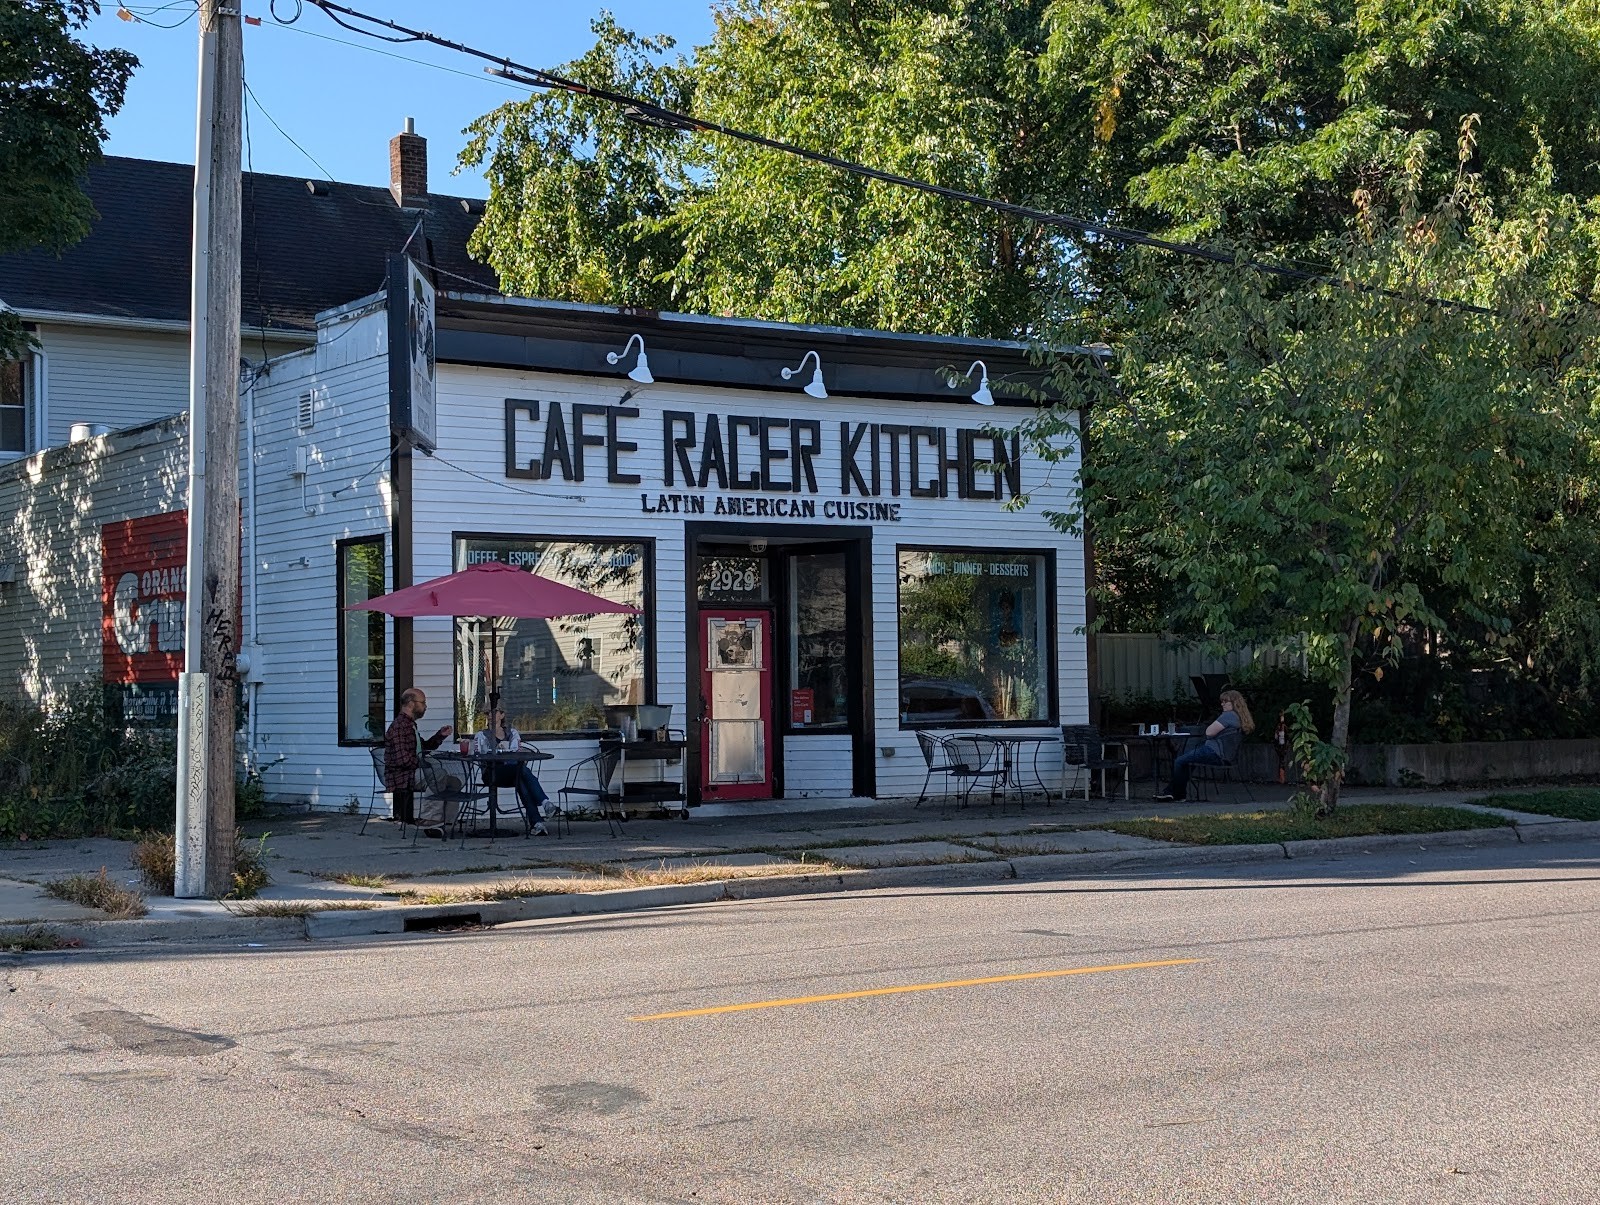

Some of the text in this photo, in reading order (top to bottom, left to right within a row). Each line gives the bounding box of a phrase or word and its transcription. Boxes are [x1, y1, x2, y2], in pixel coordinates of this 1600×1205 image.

[504, 391, 1021, 500] CAFÉ RACER KITCHEN
[641, 494, 901, 521] LATIN AMERICAN CUISINE
[467, 550, 499, 565] OFFEE
[953, 561, 983, 576] DINNER
[989, 562, 1029, 577] DESSERTS
[142, 566, 187, 597] ORANG
[710, 570, 755, 591] 2929
